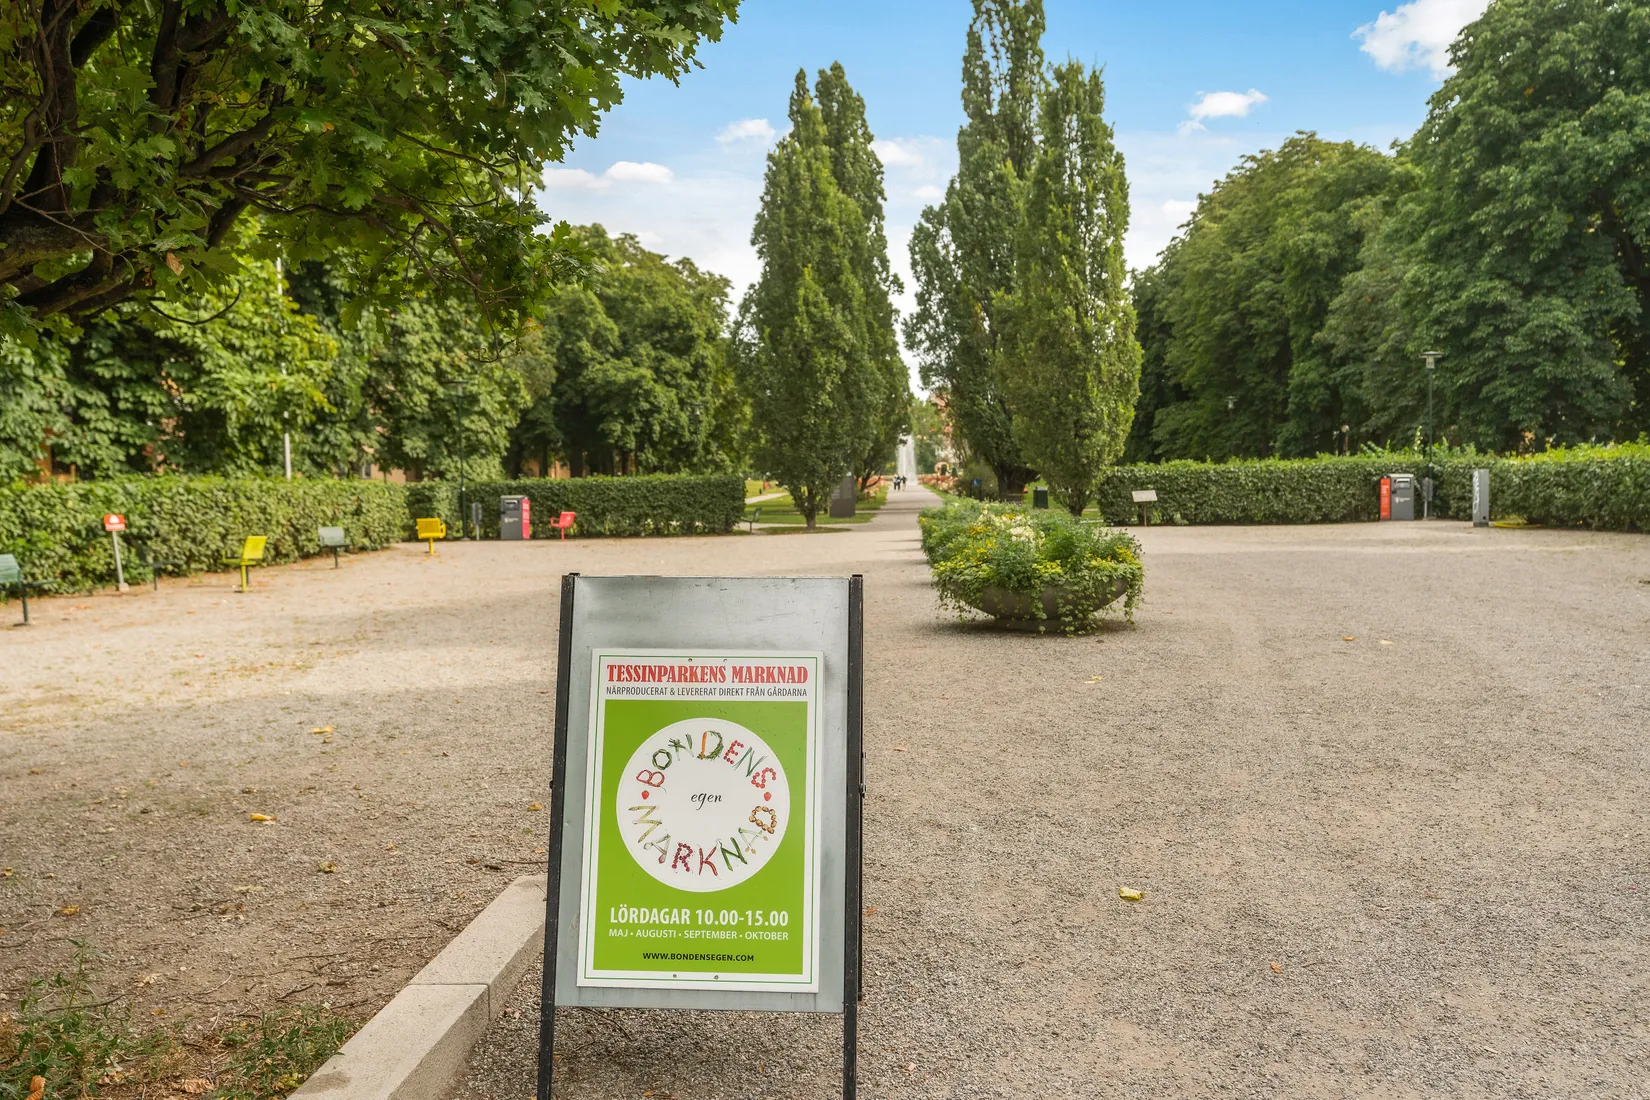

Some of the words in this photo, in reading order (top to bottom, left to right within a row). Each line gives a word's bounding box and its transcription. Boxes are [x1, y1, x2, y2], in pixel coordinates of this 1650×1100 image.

[606, 664, 727, 683] TESSINPARKENS
[731, 665, 809, 684] MARKNAD
[606, 685, 668, 696] NÄRPRODUCERAT
[669, 687, 675, 696] &
[677, 687, 717, 696] LEVERERAT
[718, 687, 744, 696] DIREKT
[746, 686, 765, 697] FRÅN
[767, 686, 808, 697] GÅRDARNA
[636, 730, 777, 793] BONDENS
[690, 792, 723, 811] egen
[628, 805, 777, 880] MARKNAD
[610, 904, 691, 925] LÖRDAGAR
[695, 909, 789, 927] 10.00-15.00
[608, 928, 629, 938] MAJ
[635, 929, 677, 938] AUGUSTI
[684, 930, 738, 940] SEPTEMBER
[744, 931, 789, 941] OKTOBER
[642, 952, 755, 962] WWW.BONDENSEGEN.COM
